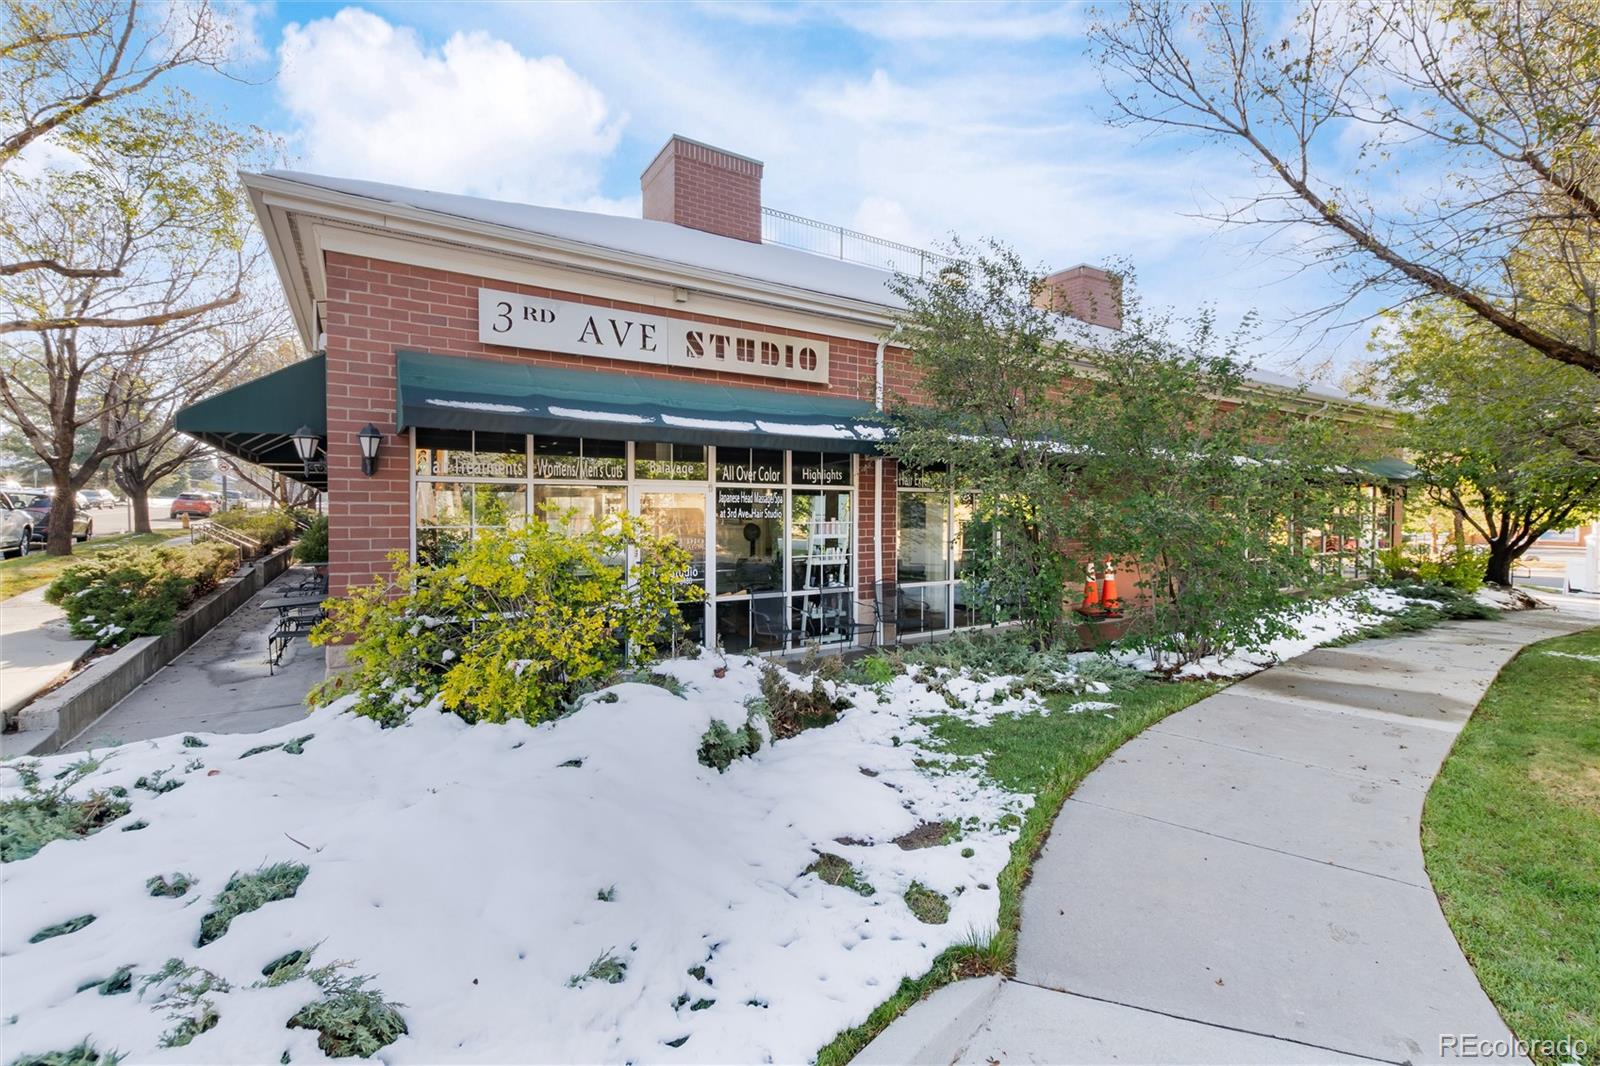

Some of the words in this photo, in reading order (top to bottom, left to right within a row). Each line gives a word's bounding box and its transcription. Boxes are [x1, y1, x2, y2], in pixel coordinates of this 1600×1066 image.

[493, 301, 556, 333] 3RD
[577, 316, 657, 352] AVE
[685, 330, 817, 372] STUDIO
[605, 460, 623, 478] Cuts
[722, 465, 734, 482] All
[736, 465, 756, 483] Over
[758, 466, 781, 483] Color
[802, 467, 843, 485] Highlights
[719, 490, 740, 507] Japanese
[741, 490, 753, 504] Head
[720, 509, 726, 519] at
[727, 507, 737, 518] 3rd
[752, 507, 763, 519] Hair
[764, 507, 783, 519] Studio
